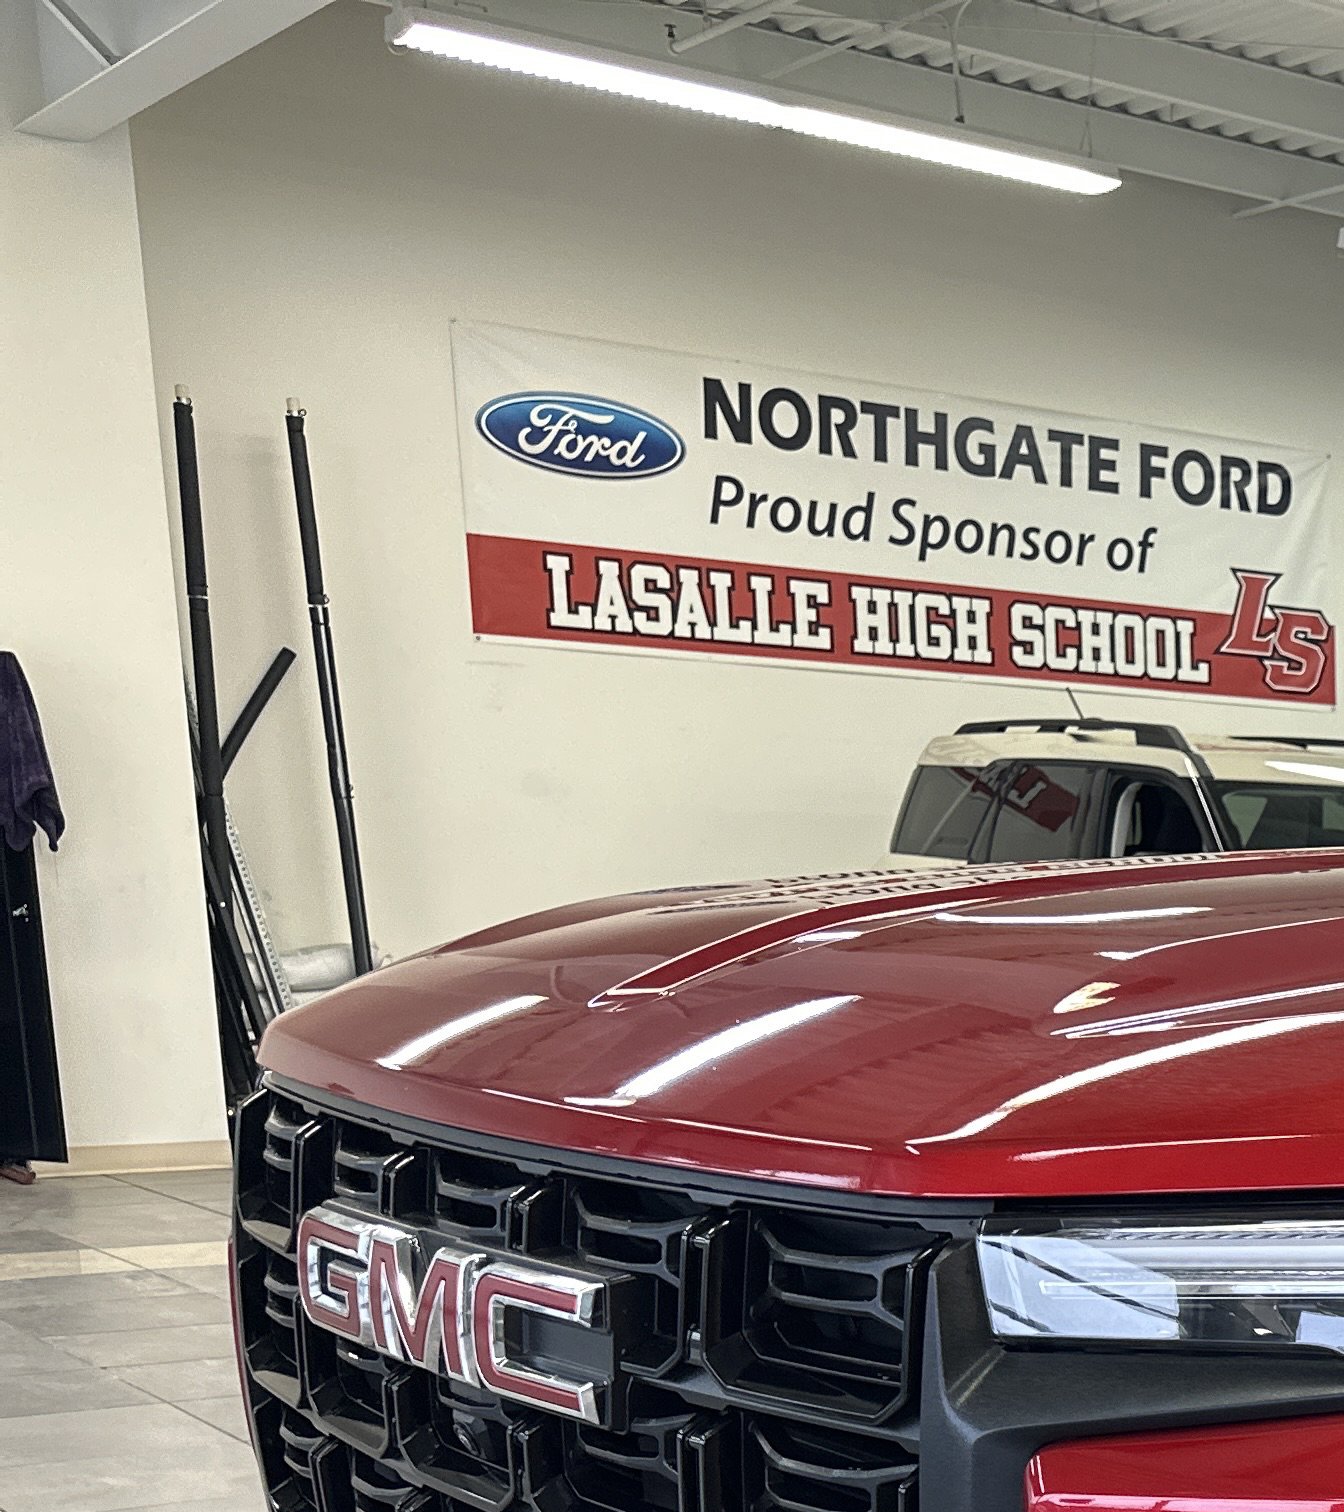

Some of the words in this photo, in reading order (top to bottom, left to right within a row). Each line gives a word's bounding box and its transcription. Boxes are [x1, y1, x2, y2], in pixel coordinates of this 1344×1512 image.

[516, 401, 647, 470] Ford
[701, 376, 1122, 496] NORTHGATE
[1138, 443, 1294, 518] FORD
[709, 475, 876, 543] Proud
[888, 498, 1096, 569] Sponsor
[1106, 527, 1157, 575] of
[543, 551, 834, 653] LASALLE
[849, 584, 994, 665] HIGH
[1009, 603, 1211, 684] SCHOOL
[1216, 568, 1331, 694] LS
[298, 1205, 606, 1425] GMC
